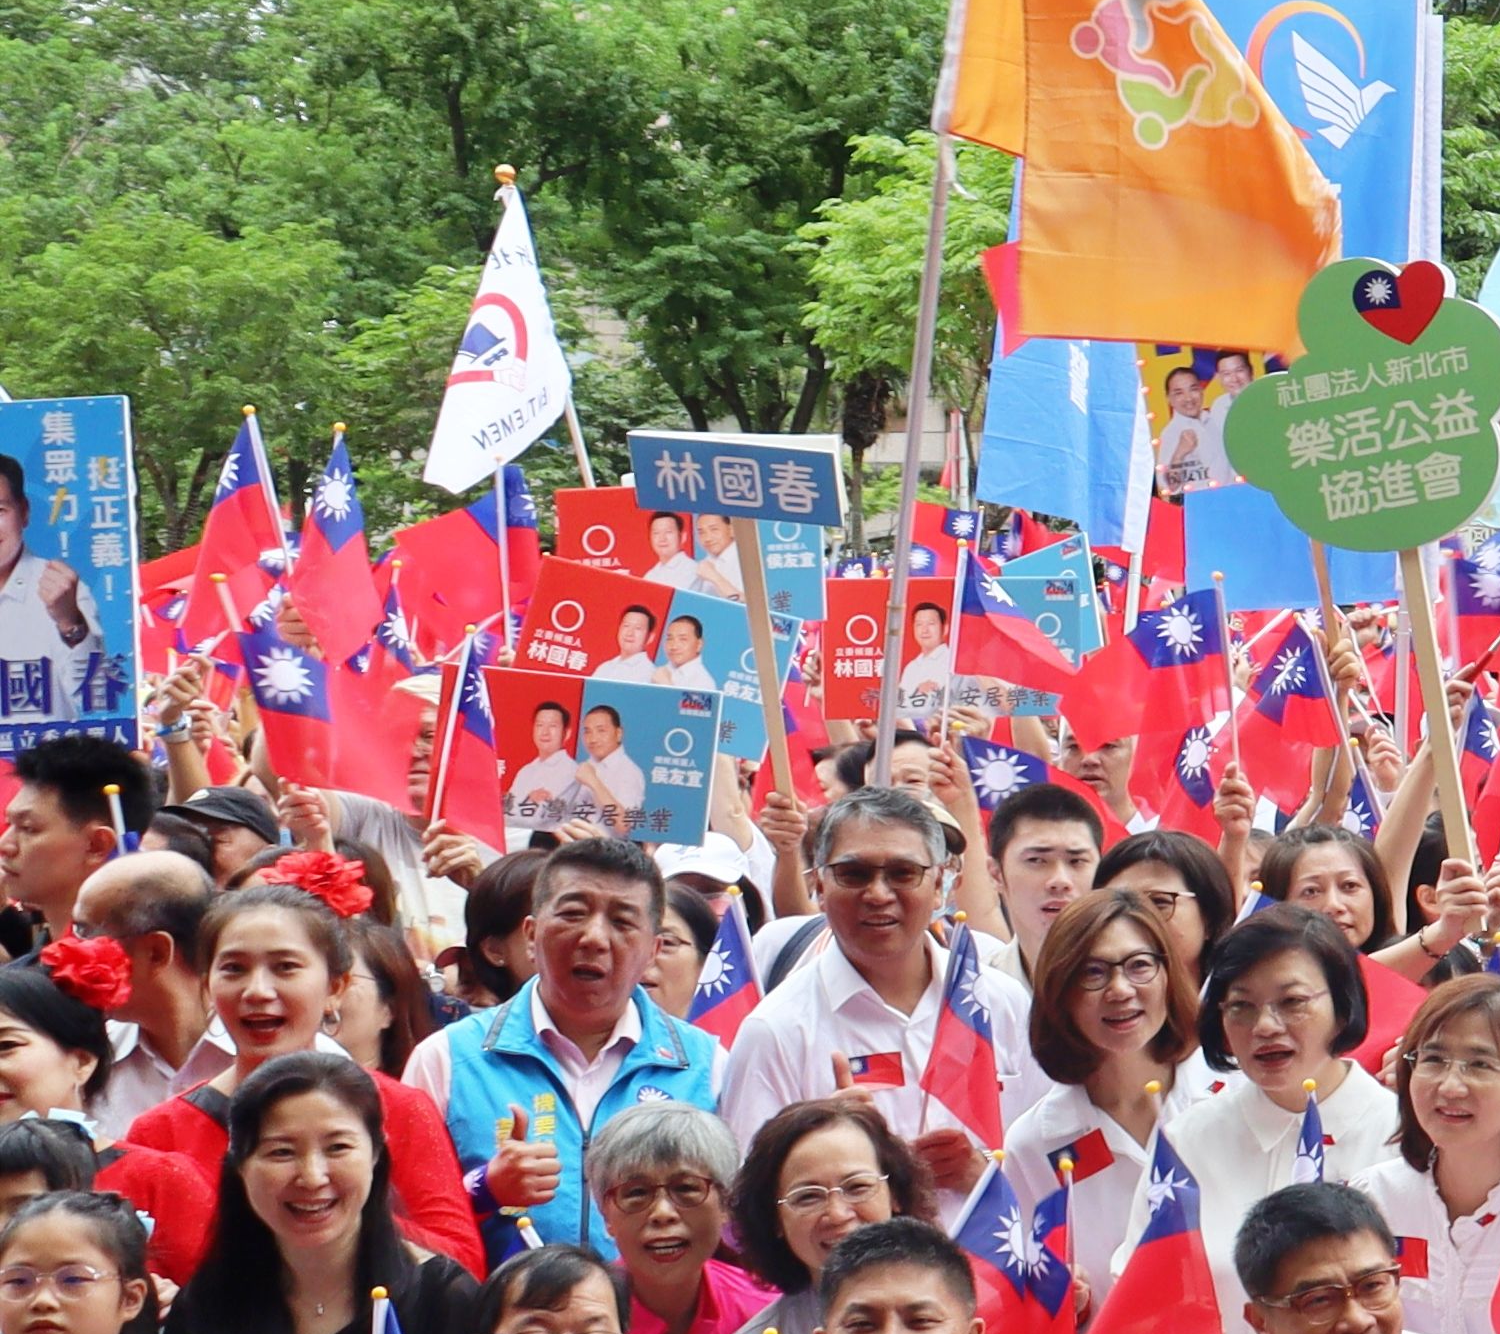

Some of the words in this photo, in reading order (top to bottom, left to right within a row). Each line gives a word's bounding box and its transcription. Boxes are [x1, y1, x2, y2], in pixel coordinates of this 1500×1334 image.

[1275, 345, 1470, 409] 社團法人新北市
[1285, 388, 1480, 469] 樂活公益
[654, 449, 821, 515] 林國春
[1318, 450, 1463, 522] 協進會
[87, 455, 127, 601] 挺正義！
[766, 550, 818, 569] 侯友宜
[527, 641, 590, 673] 林國春
[651, 766, 704, 788] 侯友宜
[571, 797, 673, 834] 安居樂業
